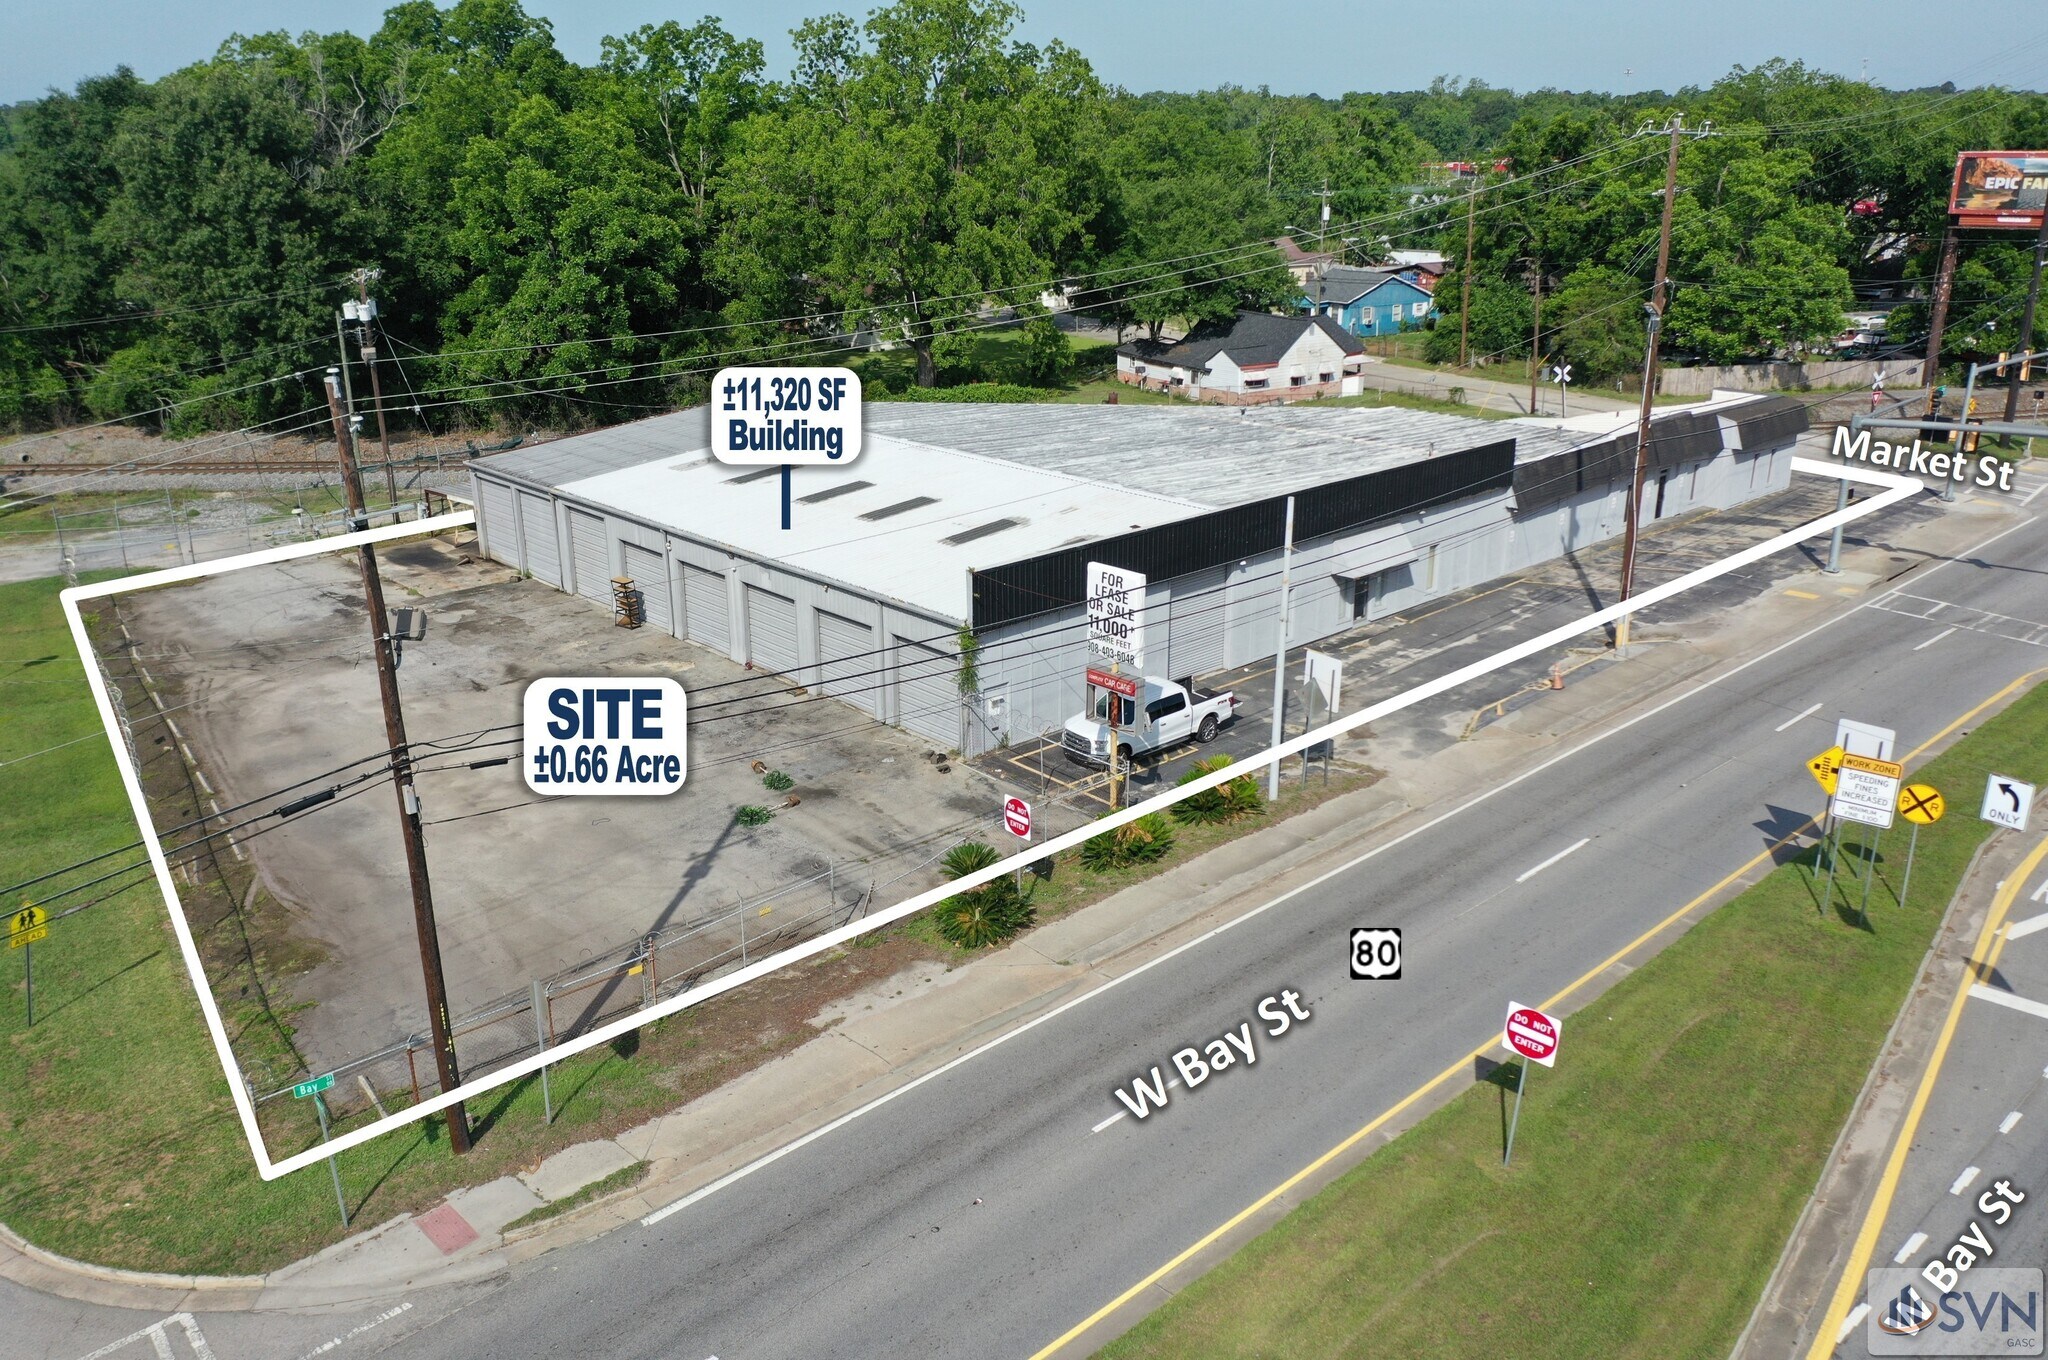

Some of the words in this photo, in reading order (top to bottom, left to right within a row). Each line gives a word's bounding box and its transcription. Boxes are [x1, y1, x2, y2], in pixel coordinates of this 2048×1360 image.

[1985, 177, 2020, 189] EPIC
[1101, 571, 1123, 589] FOR
[1095, 584, 1128, 605] LEASE
[1089, 597, 1103, 612] OR
[1107, 602, 1134, 622] SALE
[1090, 630, 1114, 645] SQUARE
[1116, 638, 1131, 650] FEET
[1104, 677, 1116, 687] CAR
[1116, 681, 1131, 692] CARE
[1846, 758, 1871, 768] WORK
[1873, 763, 1897, 775] ZONE
[1848, 772, 1889, 788] SPEEDING
[1854, 783, 1878, 794] FINES
[1842, 790, 1888, 806] INCREASED
[1902, 796, 1911, 806] R
[1007, 802, 1015, 811] DO
[1017, 806, 1027, 816] NOT
[1848, 805, 1877, 815] MINIMUM
[1930, 802, 1939, 812] R
[1989, 808, 2020, 824] ONLY
[1010, 820, 1025, 832] ENTER
[15, 931, 43, 946] AHEAD
[1514, 1012, 1528, 1025] DO
[1532, 1020, 1553, 1034] NOT
[1514, 1034, 1545, 1054] ENTER
[300, 1084, 318, 1095] Bay
